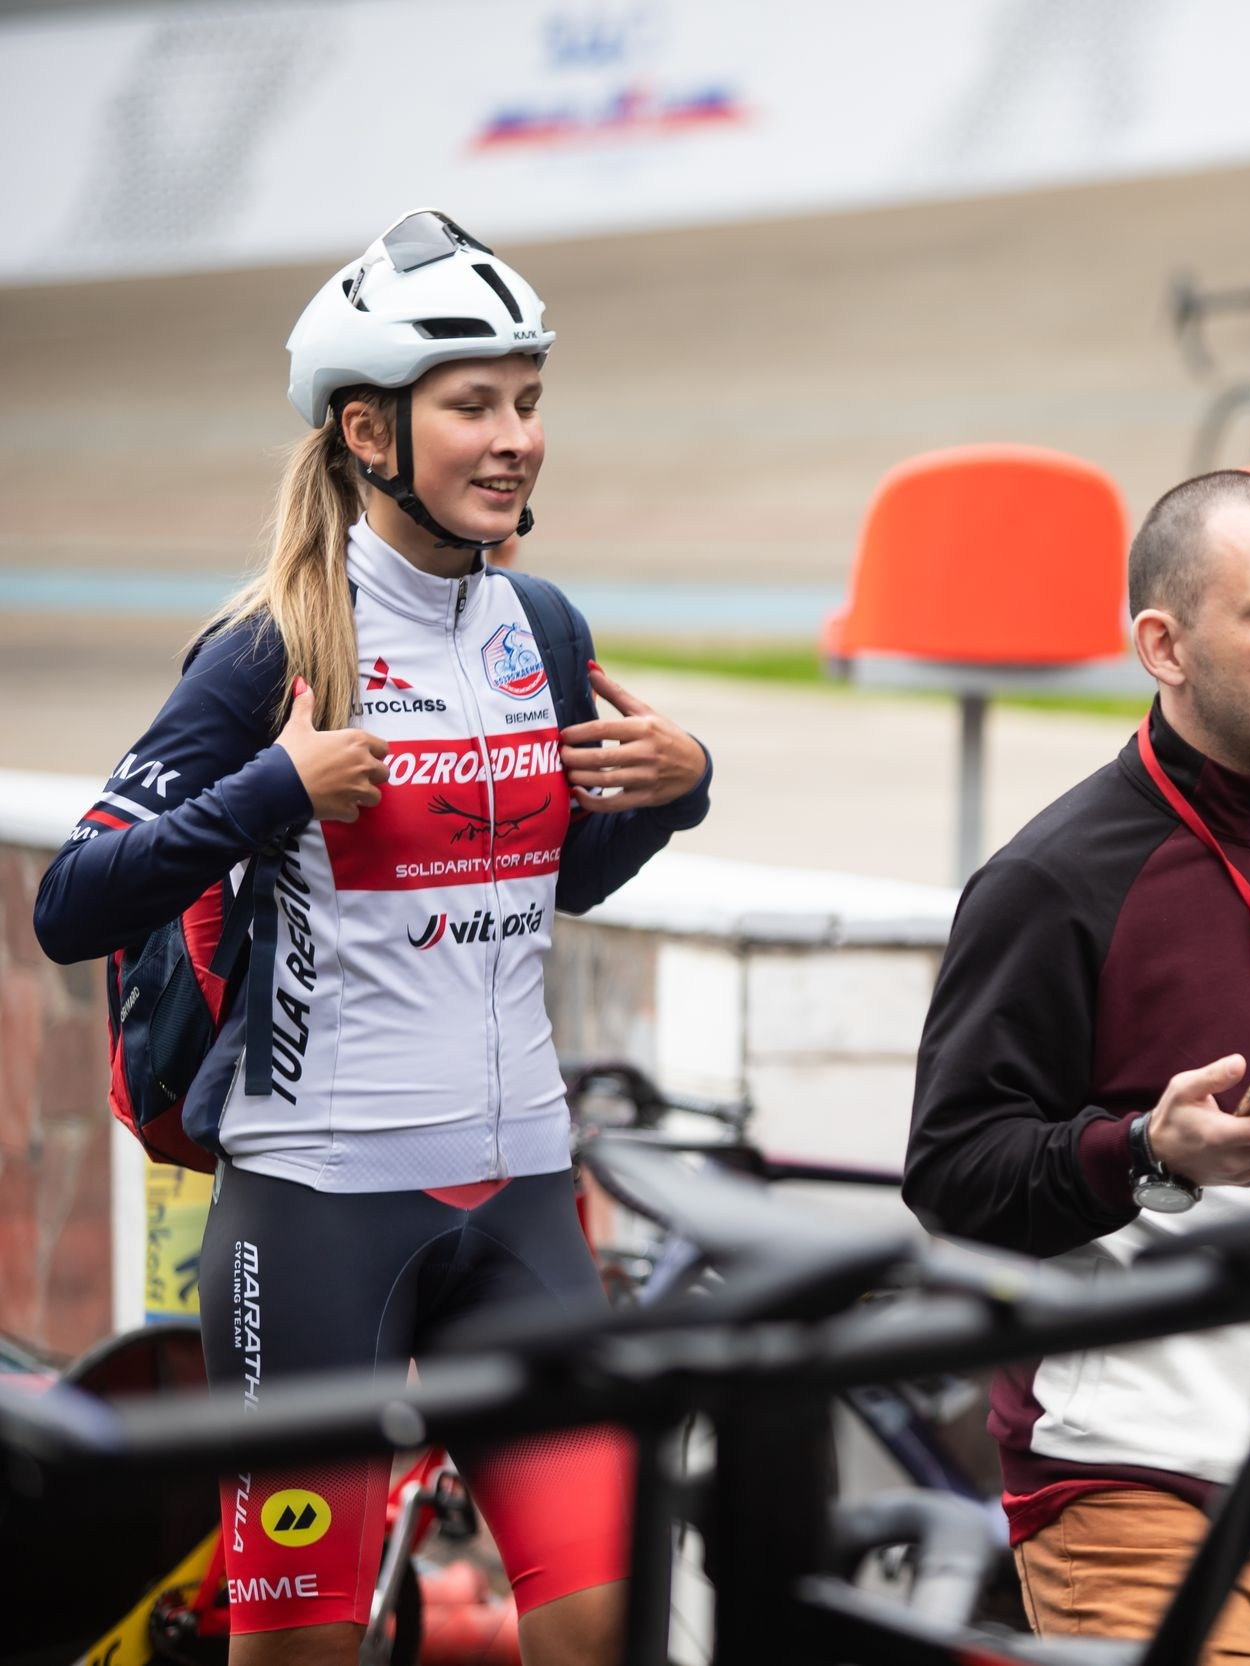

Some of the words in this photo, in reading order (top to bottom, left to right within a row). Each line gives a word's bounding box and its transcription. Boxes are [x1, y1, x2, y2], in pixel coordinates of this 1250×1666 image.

[350, 699, 447, 717] UTOCLASS
[505, 709, 549, 725] BIEMME
[396, 857, 492, 878] SOLIDARITY
[495, 854, 519, 869] FOR
[523, 847, 561, 865] PEACE
[450, 903, 544, 944] vitoria
[233, 1240, 242, 1304] CYCLING
[233, 1307, 242, 1348] TEAM
[233, 1472, 251, 1552] TULA
